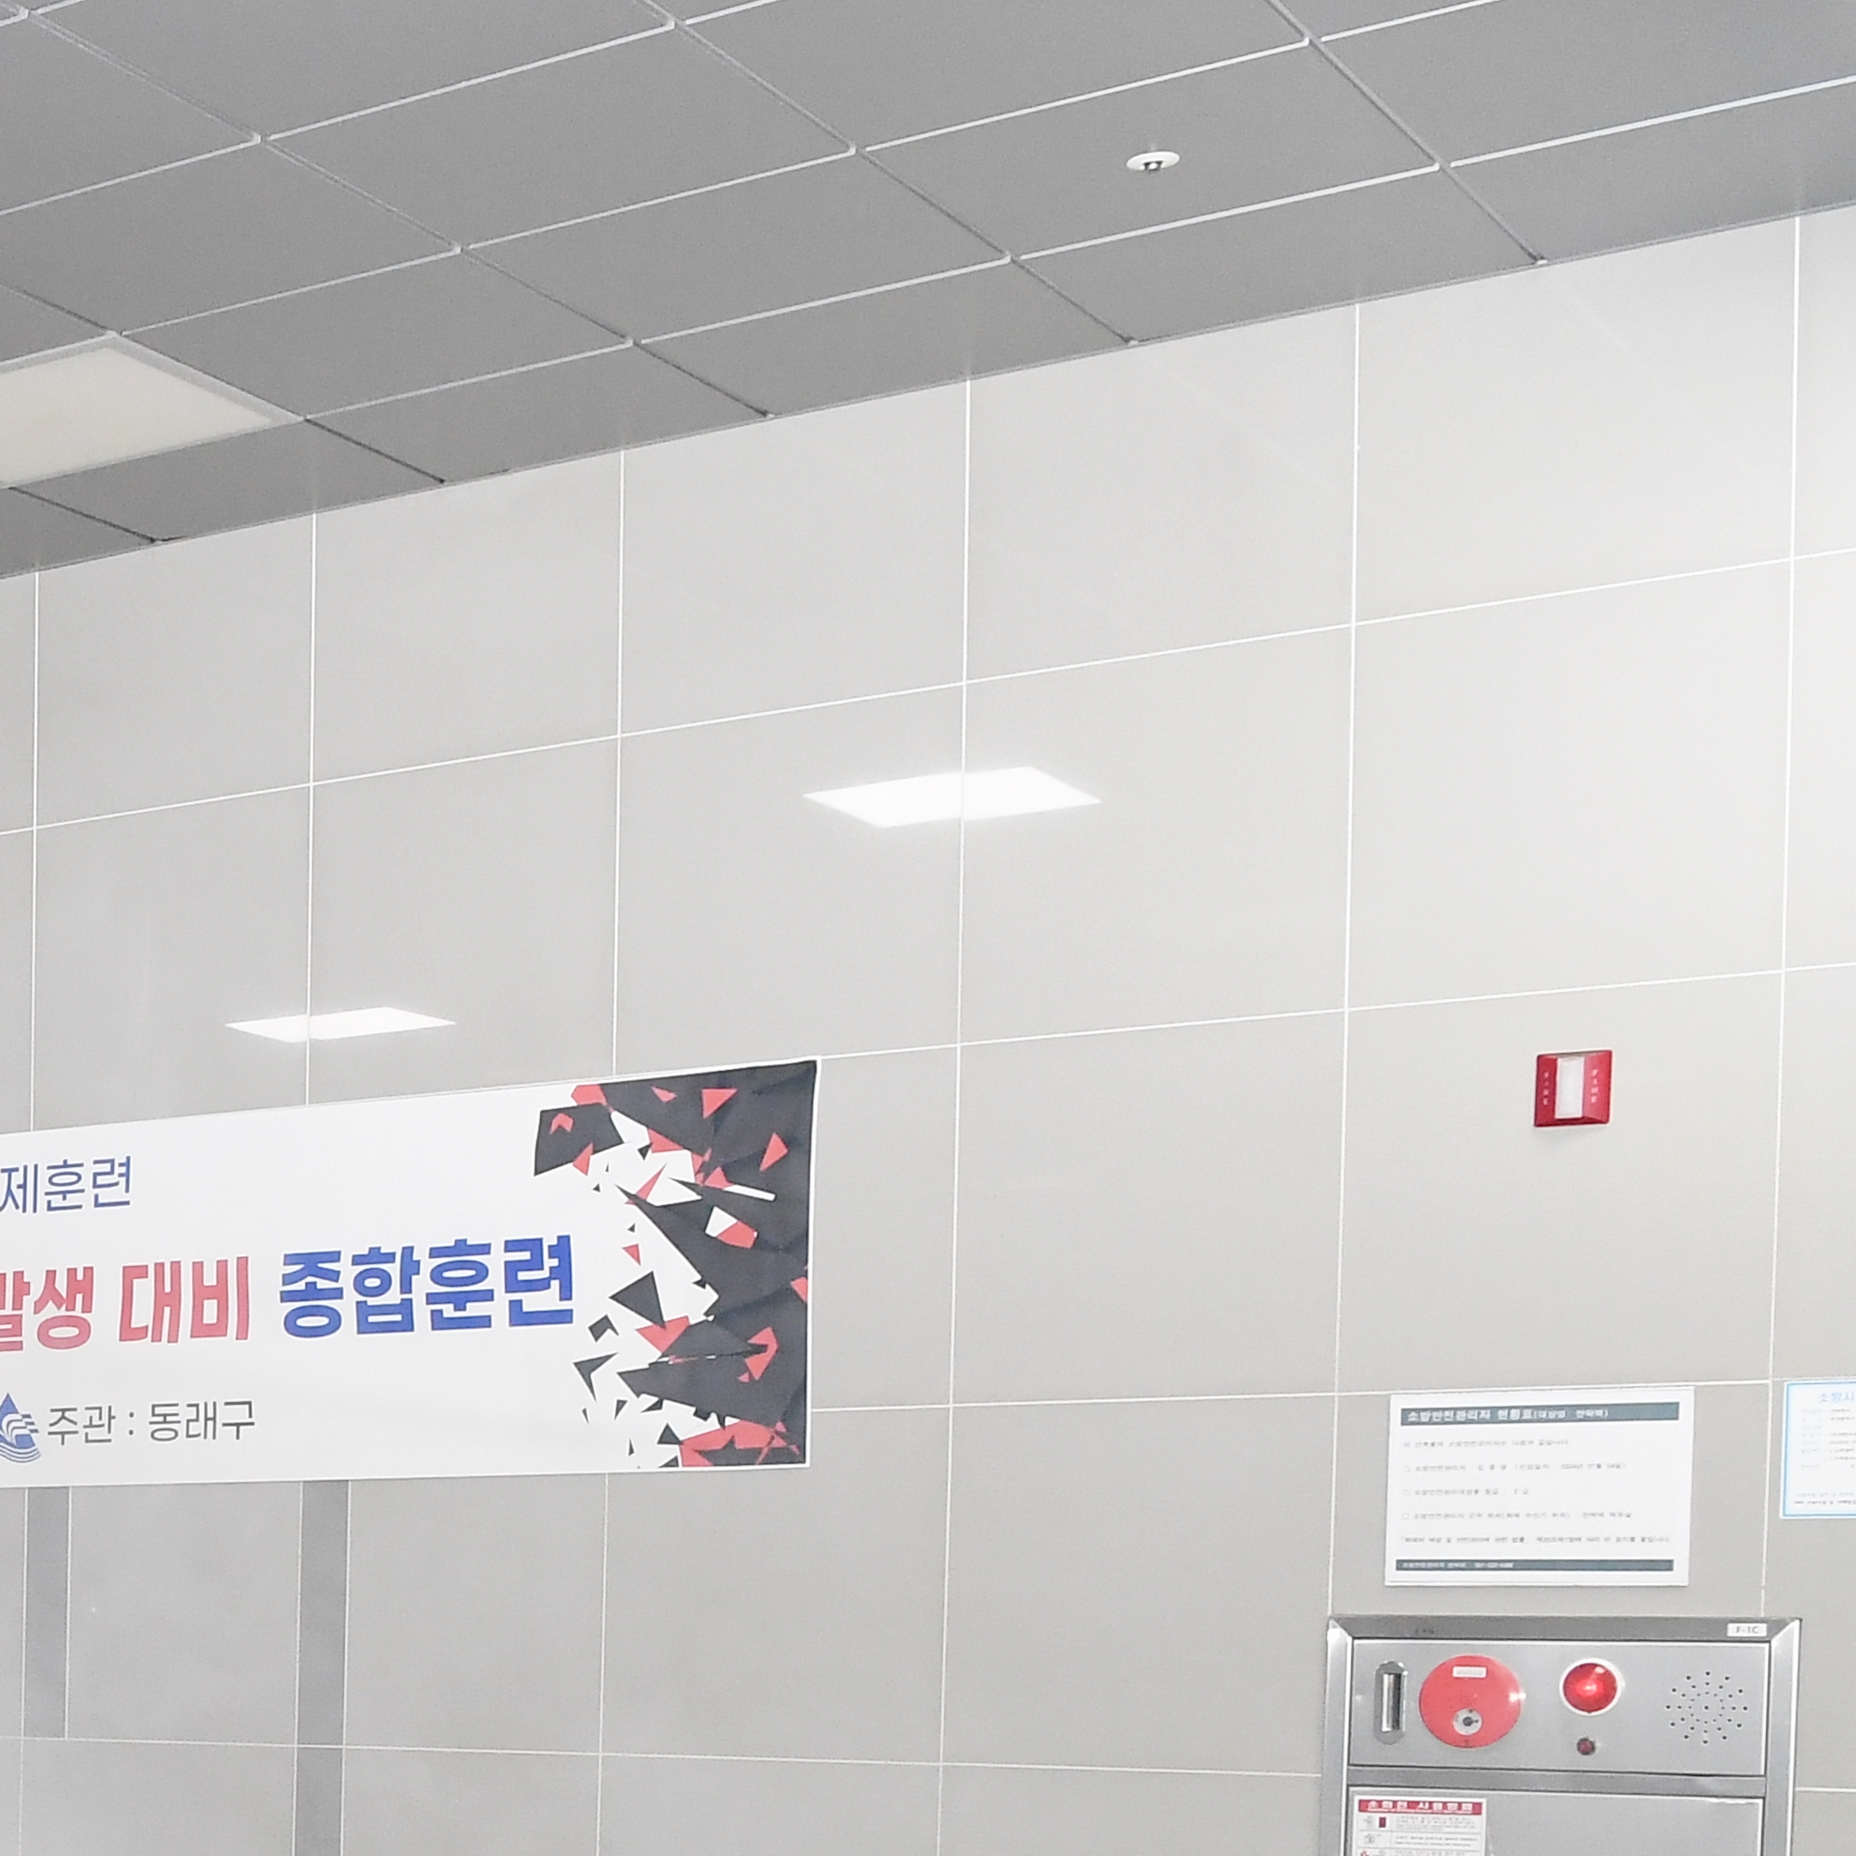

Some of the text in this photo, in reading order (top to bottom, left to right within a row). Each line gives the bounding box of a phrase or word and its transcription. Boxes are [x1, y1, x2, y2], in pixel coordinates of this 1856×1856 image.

[118, 1256, 252, 1345] 대비
[278, 1234, 576, 1340] 종합훈련
[47, 1404, 118, 1447] 주관
[148, 1400, 258, 1444] 동래구
[1406, 1408, 1491, 1422] 소방안전관리자
[1736, 1625, 1759, 1634] F-1C
